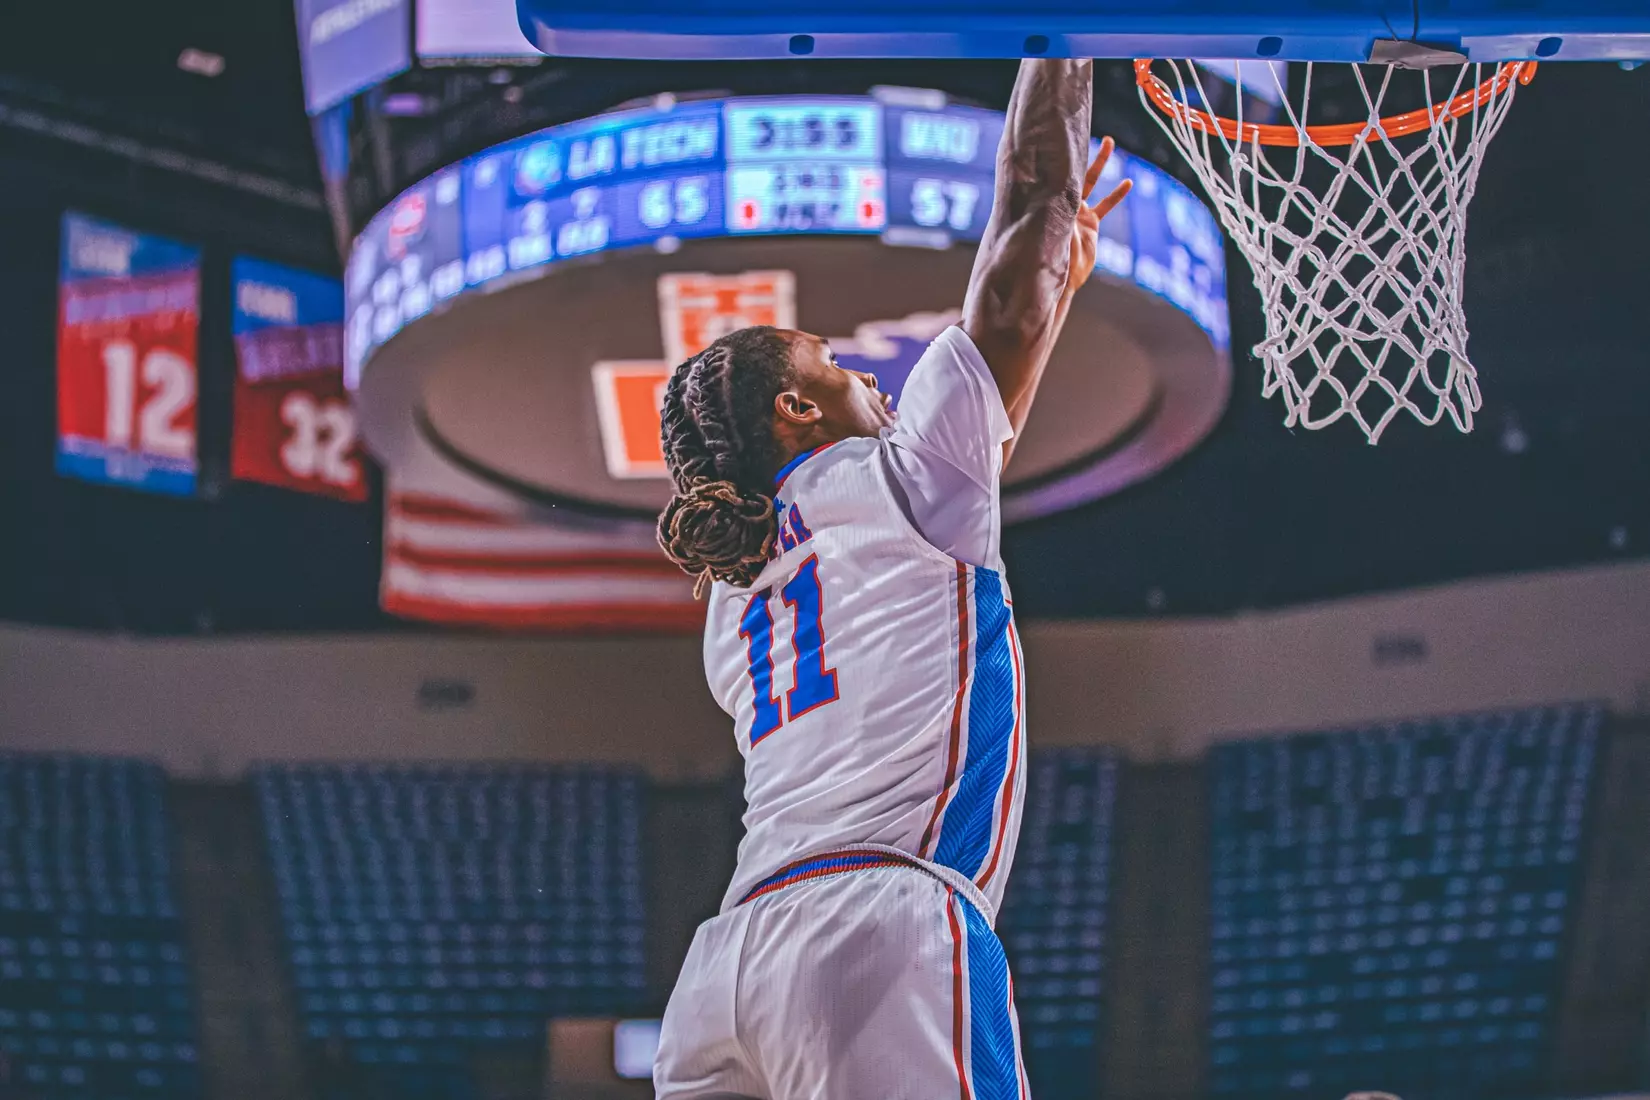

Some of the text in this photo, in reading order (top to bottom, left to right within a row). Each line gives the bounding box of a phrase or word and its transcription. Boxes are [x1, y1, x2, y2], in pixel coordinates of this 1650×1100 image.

[567, 118, 718, 180] LA TECH
[638, 175, 710, 229] 65
[910, 177, 980, 230] 57
[102, 340, 197, 461] 12
[279, 391, 360, 488] 32
[769, 501, 814, 562] ER
[738, 552, 840, 750] 11
